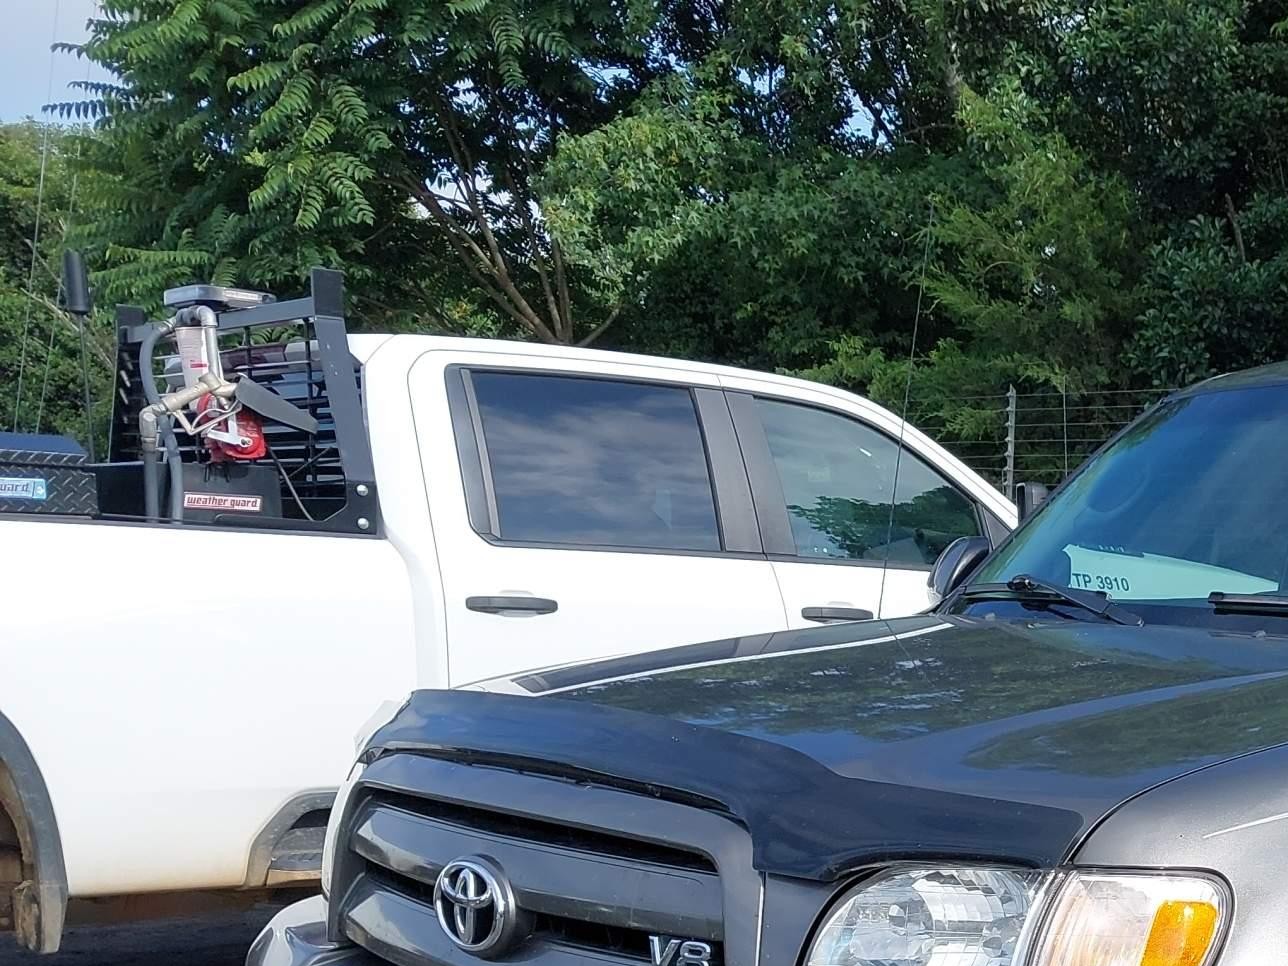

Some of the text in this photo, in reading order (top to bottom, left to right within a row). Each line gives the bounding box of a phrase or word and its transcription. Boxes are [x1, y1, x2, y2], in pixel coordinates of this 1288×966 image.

[187, 495, 258, 508] weather guard
[1072, 572, 1129, 591] TP 3910
